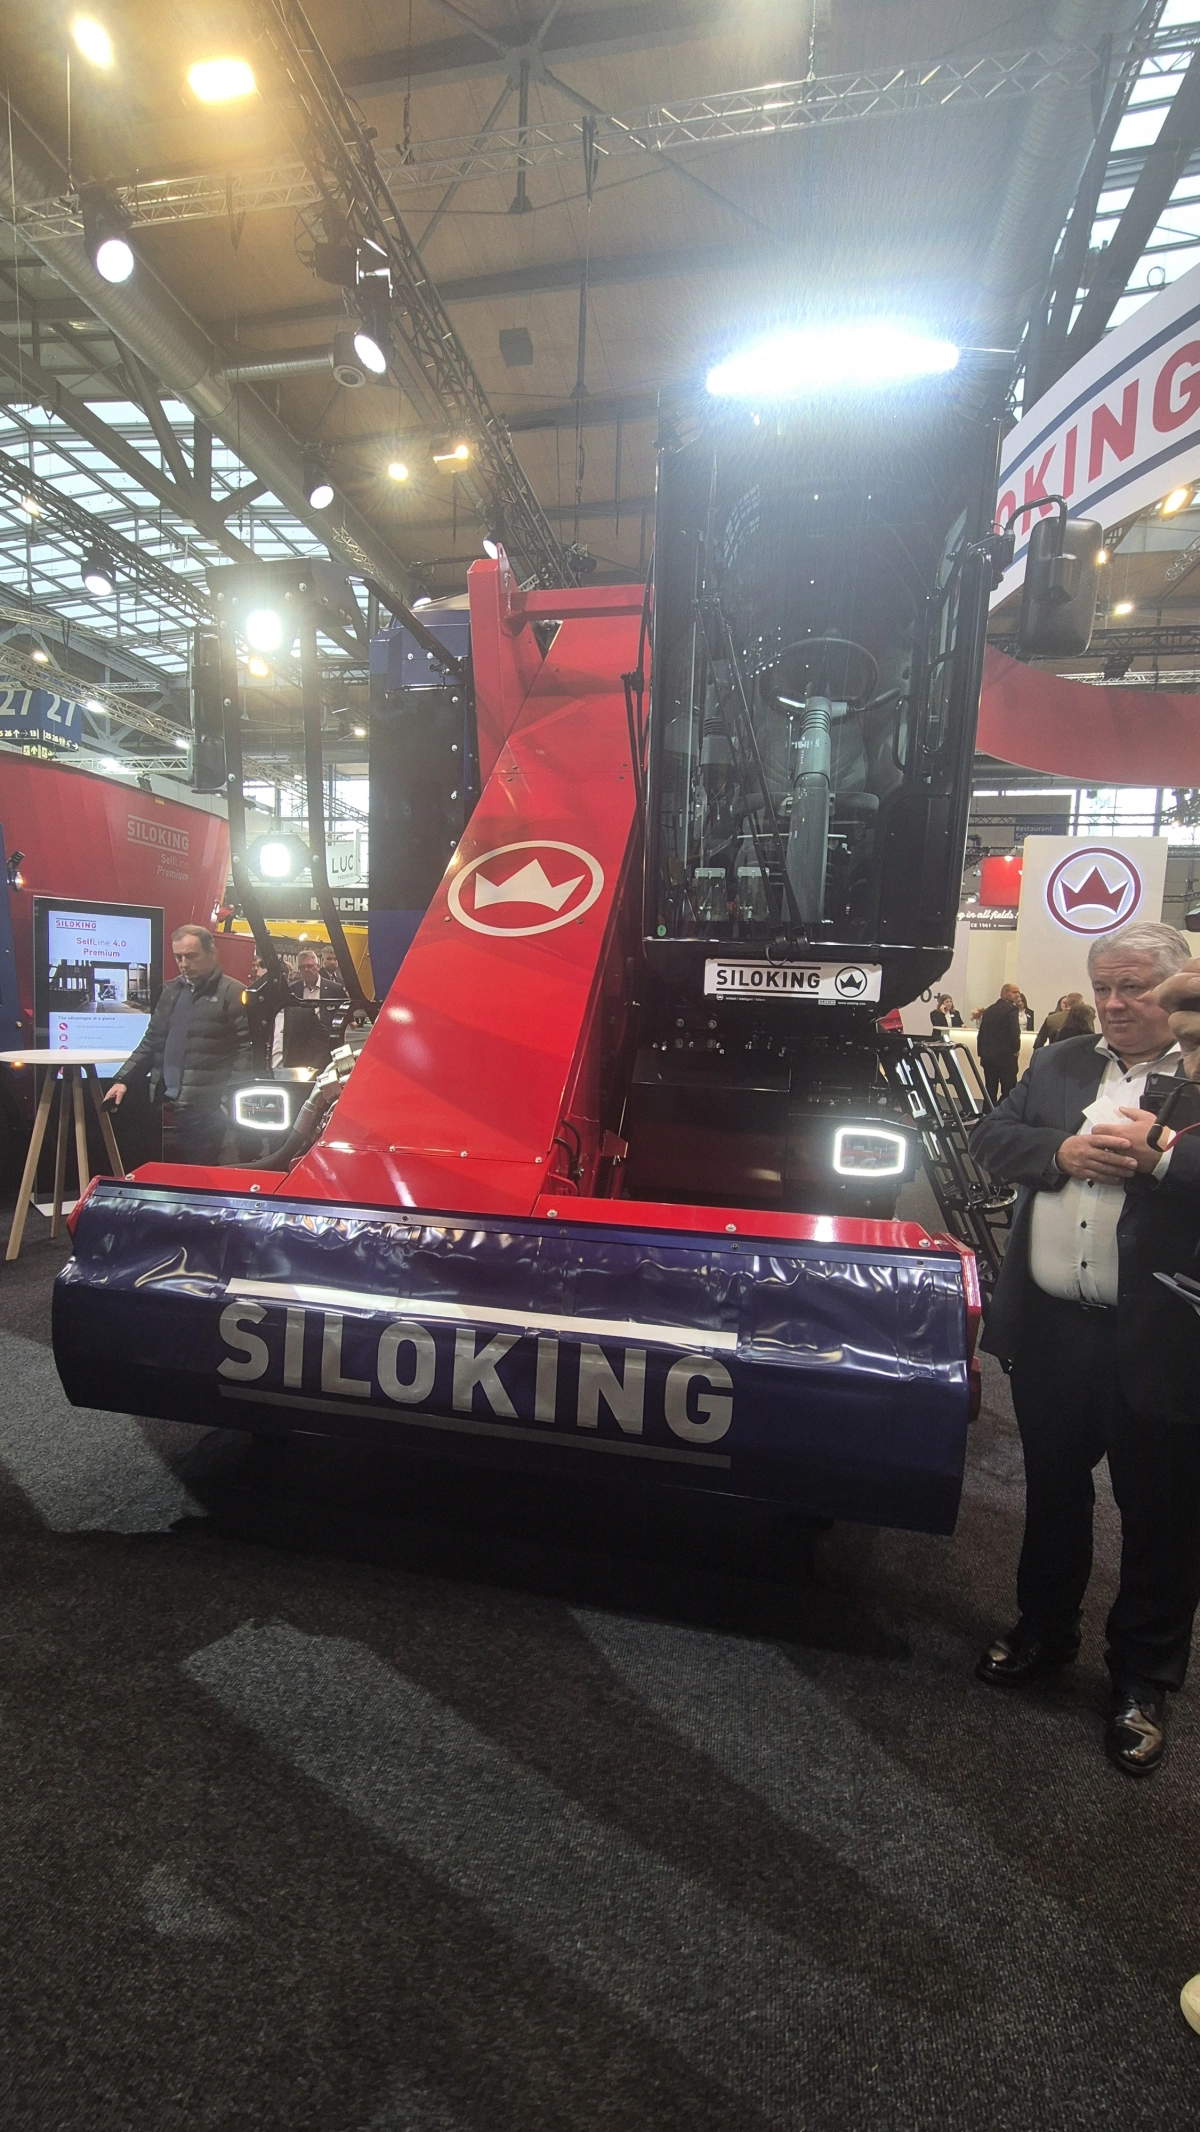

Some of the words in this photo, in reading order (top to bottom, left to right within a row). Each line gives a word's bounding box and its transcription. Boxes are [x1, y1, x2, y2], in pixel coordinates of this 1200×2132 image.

[47, 691, 76, 727] 27
[127, 820, 189, 850] SILOKING
[157, 866, 189, 881] Premium
[977, 909, 991, 919] all
[55, 920, 97, 929] SILOKING
[76, 937, 110, 947] SelfLine
[112, 940, 127, 948] 4.0
[83, 948, 120, 957] Premium
[716, 969, 821, 989] SILOKING
[216, 1301, 734, 1444] SILOKING
